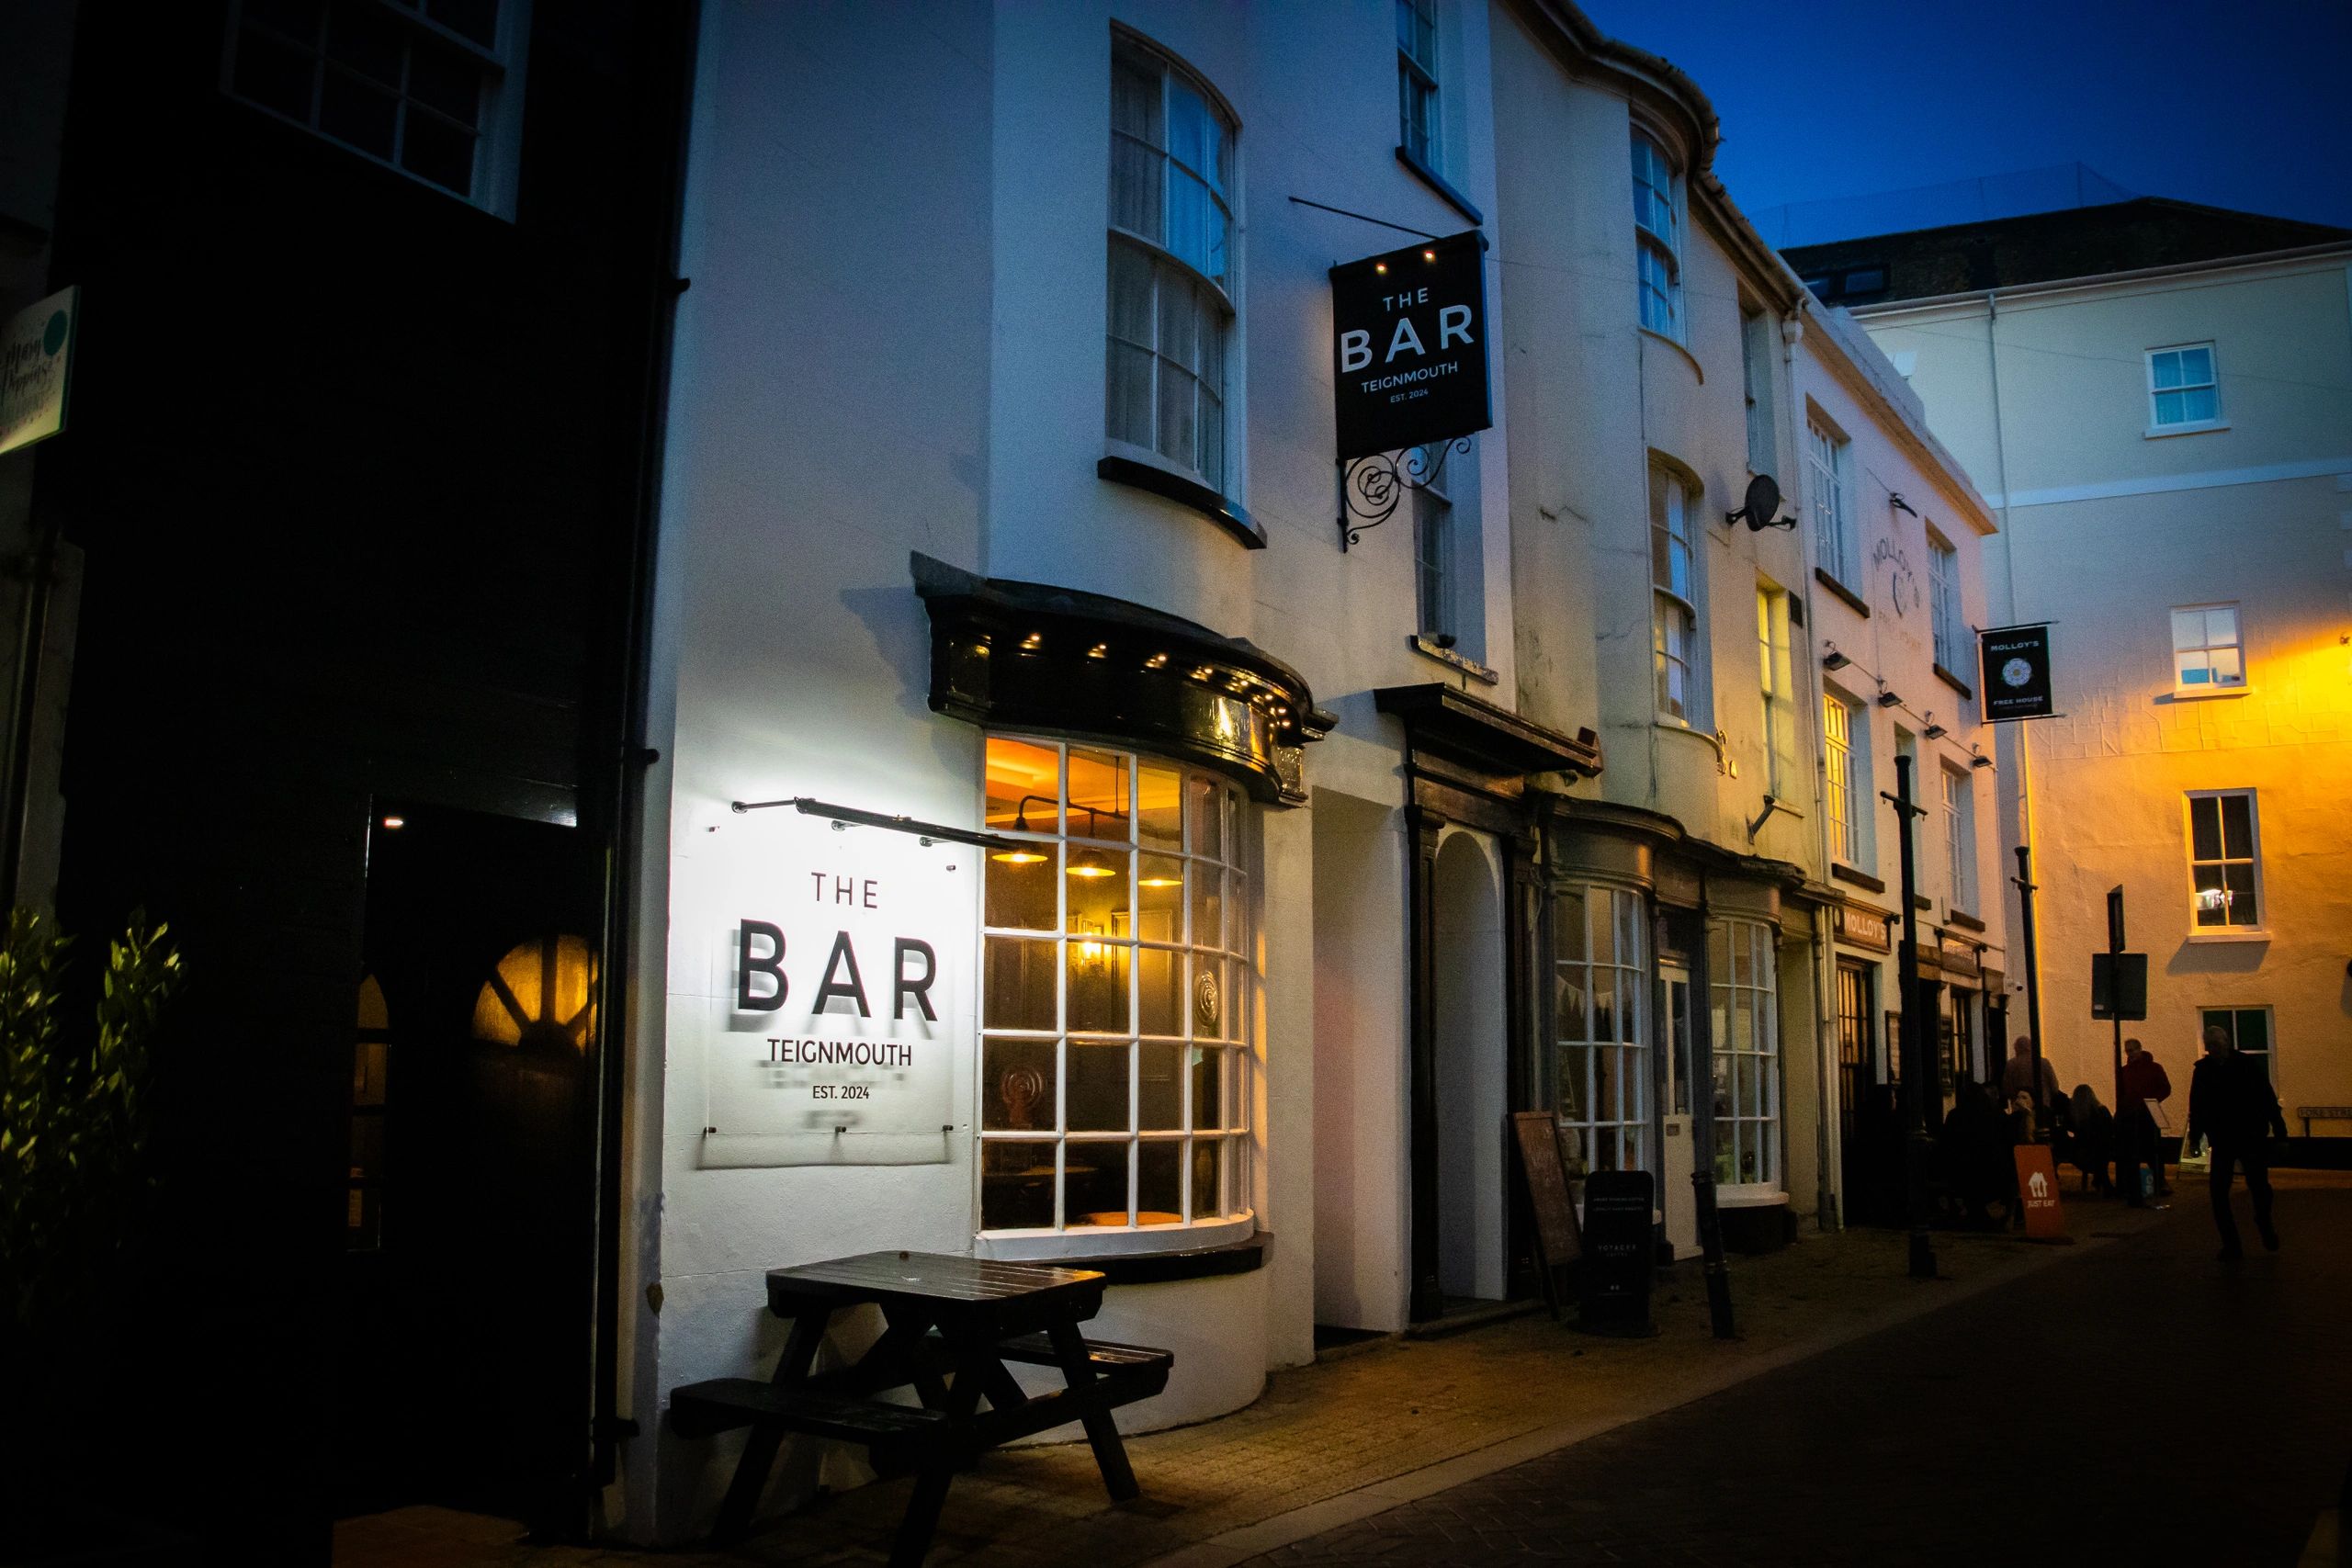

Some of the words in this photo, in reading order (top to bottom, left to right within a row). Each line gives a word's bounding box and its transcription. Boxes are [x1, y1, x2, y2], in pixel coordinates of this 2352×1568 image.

[1383, 288, 1429, 311] THE
[1340, 304, 1475, 374] BAR
[1362, 361, 1458, 393] TEIGNMOUTH
[1390, 393, 1408, 403] EST.
[1409, 389, 1429, 400] 2024
[1990, 640, 2040, 651] MOLLOY'S
[2016, 695, 2043, 704] HOUSE
[810, 872, 877, 908] THE
[738, 919, 937, 1021] BAR
[767, 1038, 911, 1066] TEIGNMOUTH
[812, 1086, 838, 1100] EST.
[842, 1086, 869, 1100] 2024
[2028, 1200, 2041, 1208] JUST
